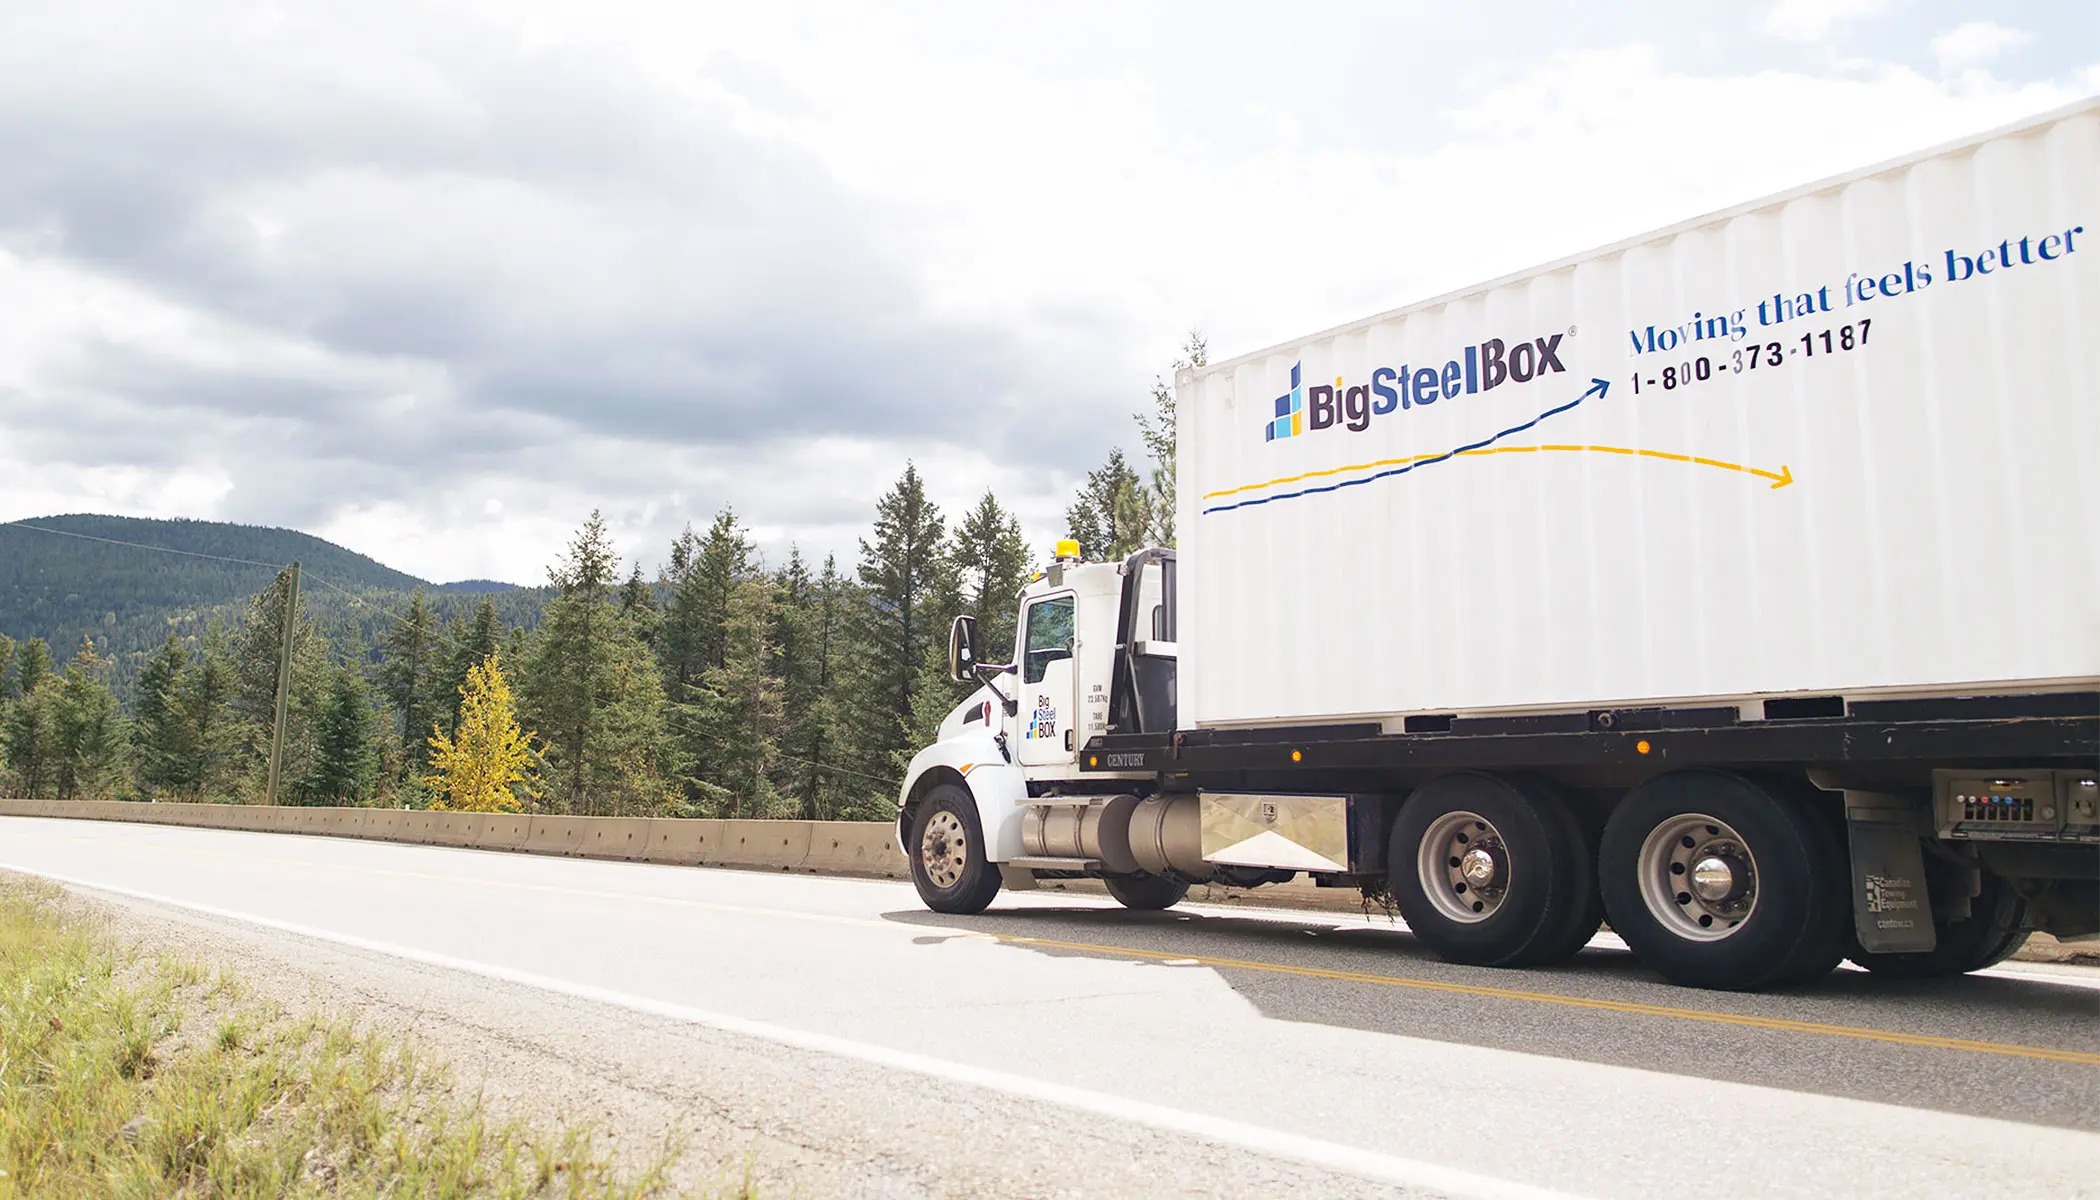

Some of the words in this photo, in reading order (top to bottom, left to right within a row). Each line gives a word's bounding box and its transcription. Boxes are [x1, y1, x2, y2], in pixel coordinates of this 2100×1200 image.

[1629, 312, 1747, 358] Moving
[1757, 285, 1835, 328] that
[1844, 261, 1933, 307] feels
[1944, 226, 2085, 282] better
[1631, 318, 1873, 395] 1-800-373-1187
[1309, 334, 1566, 432] BigSteelBox
[1038, 695, 1050, 709] Big
[1038, 708, 1056, 721] Steel
[1038, 721, 1056, 738] BOX
[1107, 753, 1145, 767] CENTURY
